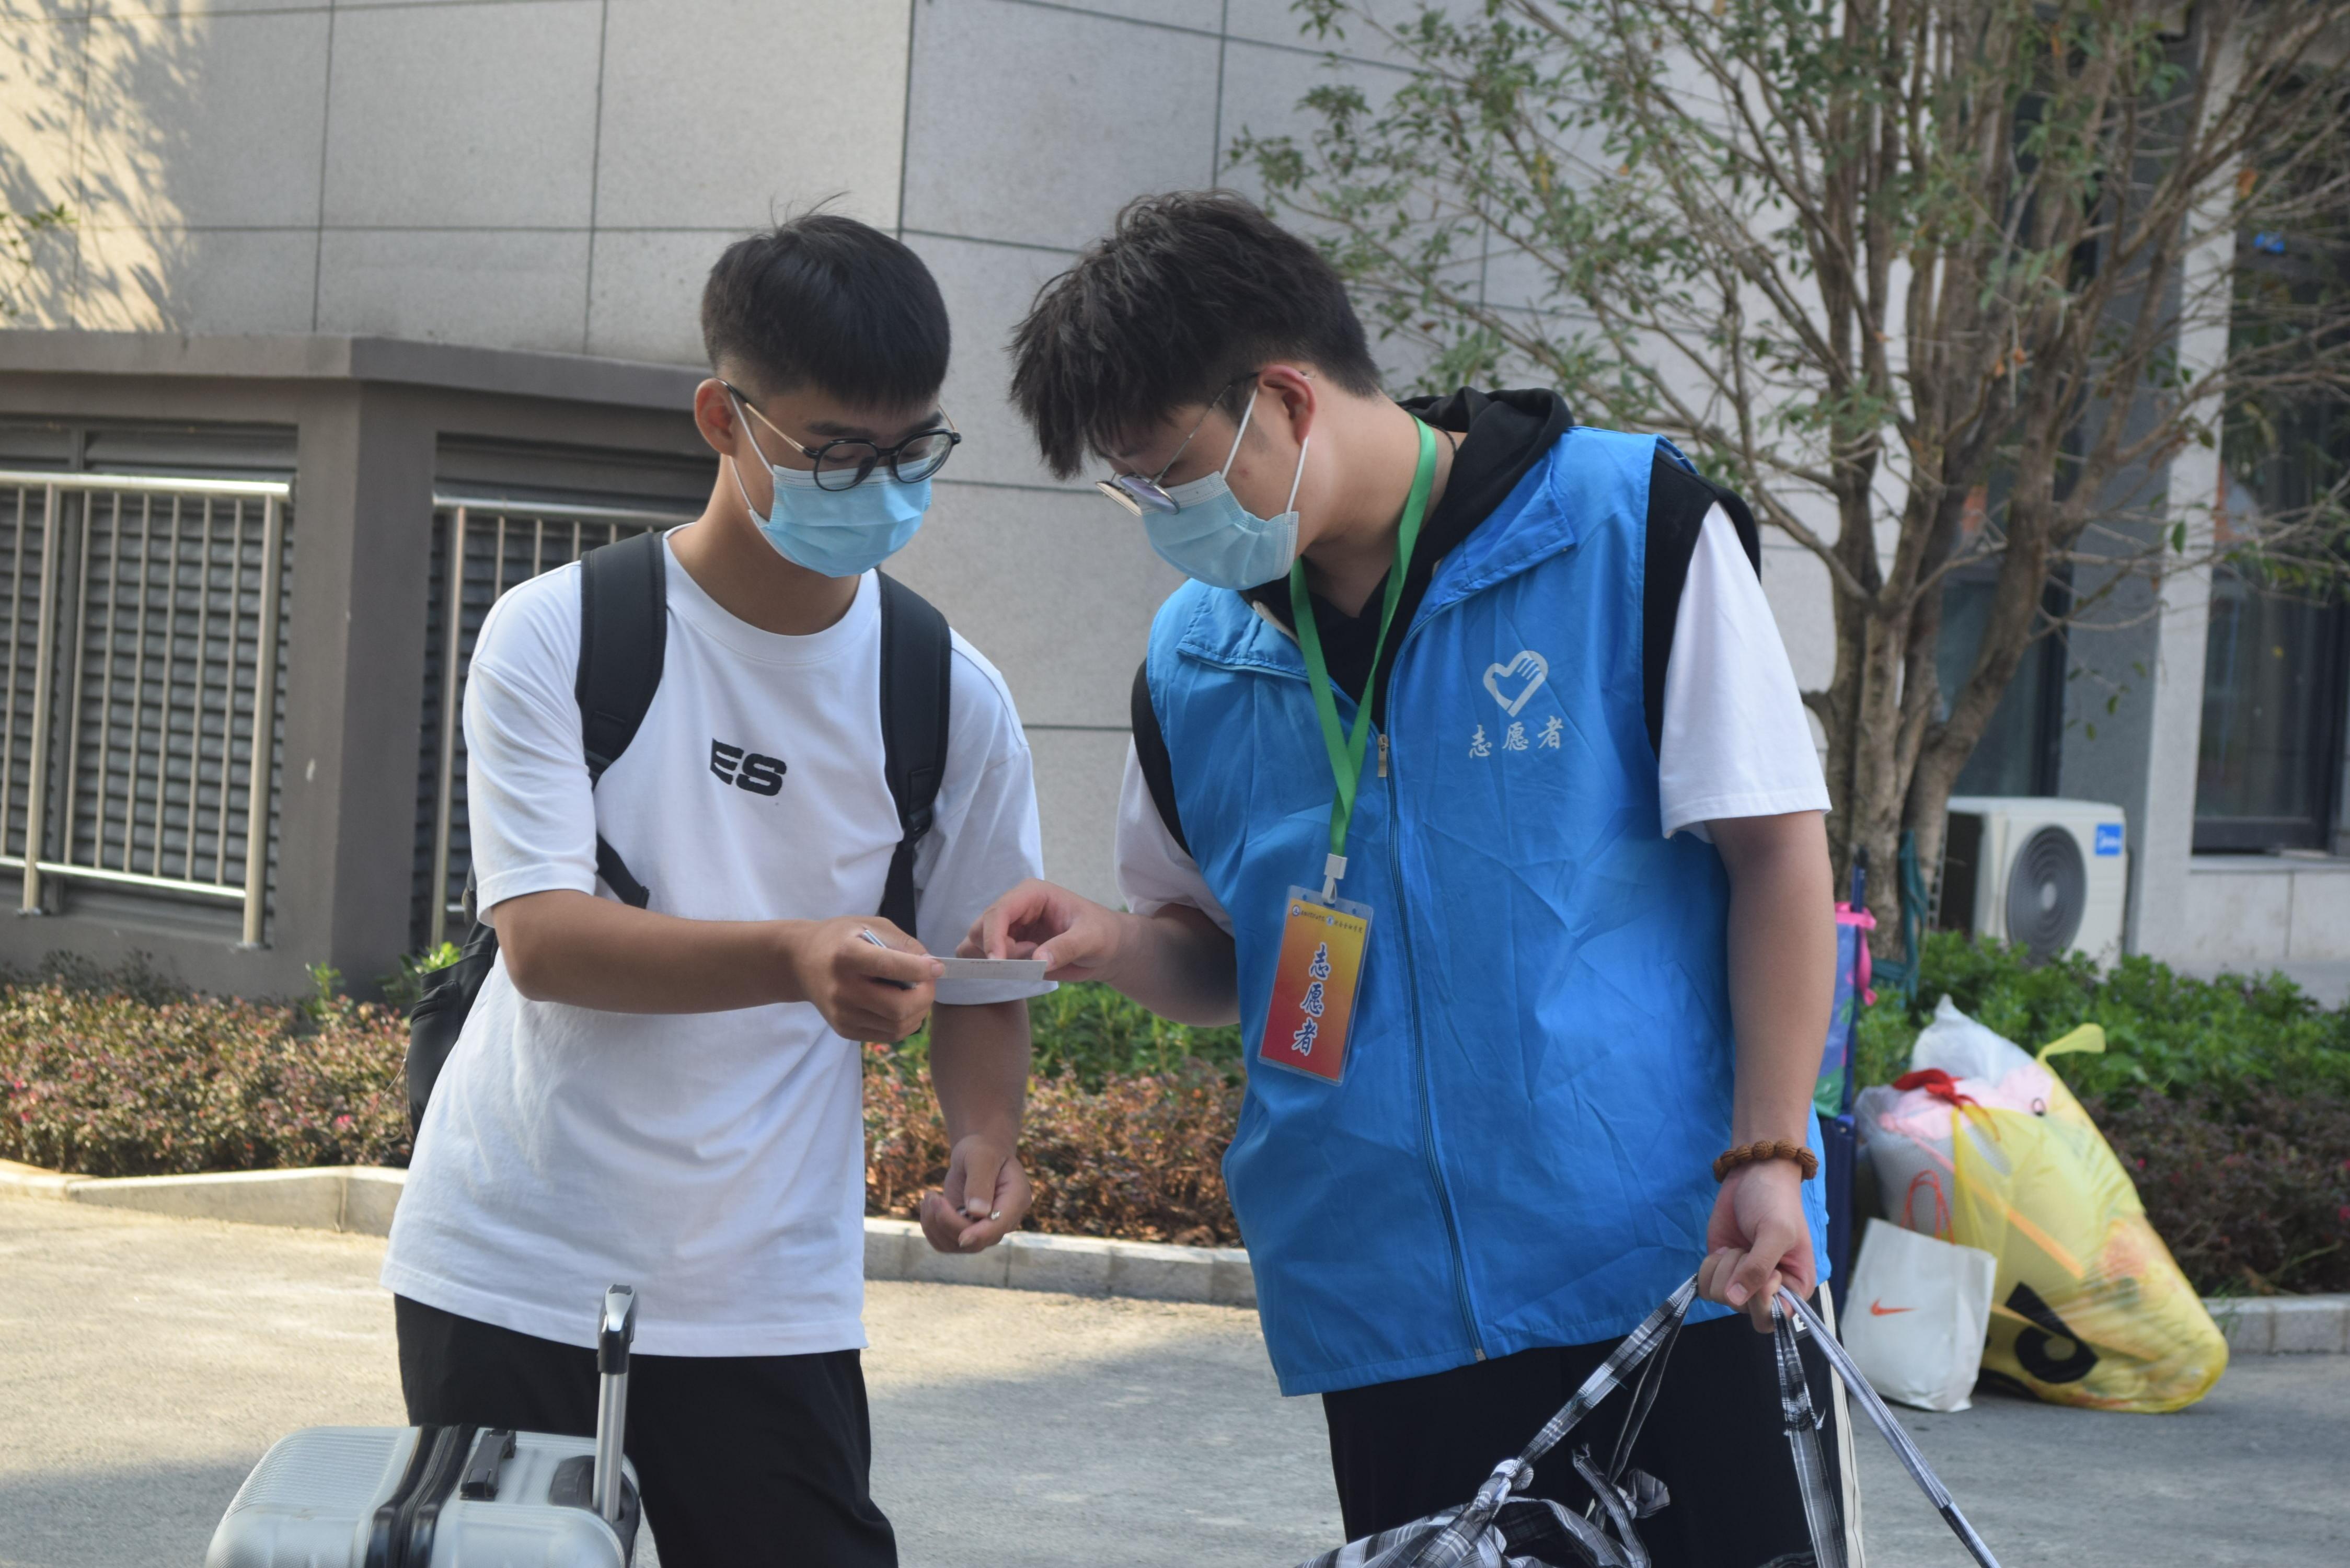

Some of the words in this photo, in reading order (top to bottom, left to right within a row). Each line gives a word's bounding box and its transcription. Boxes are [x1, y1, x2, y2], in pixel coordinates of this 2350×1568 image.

[1469, 714, 1563, 759] 志愿者
[710, 737, 787, 797] ES
[1291, 941, 1331, 1056] 志愿者
